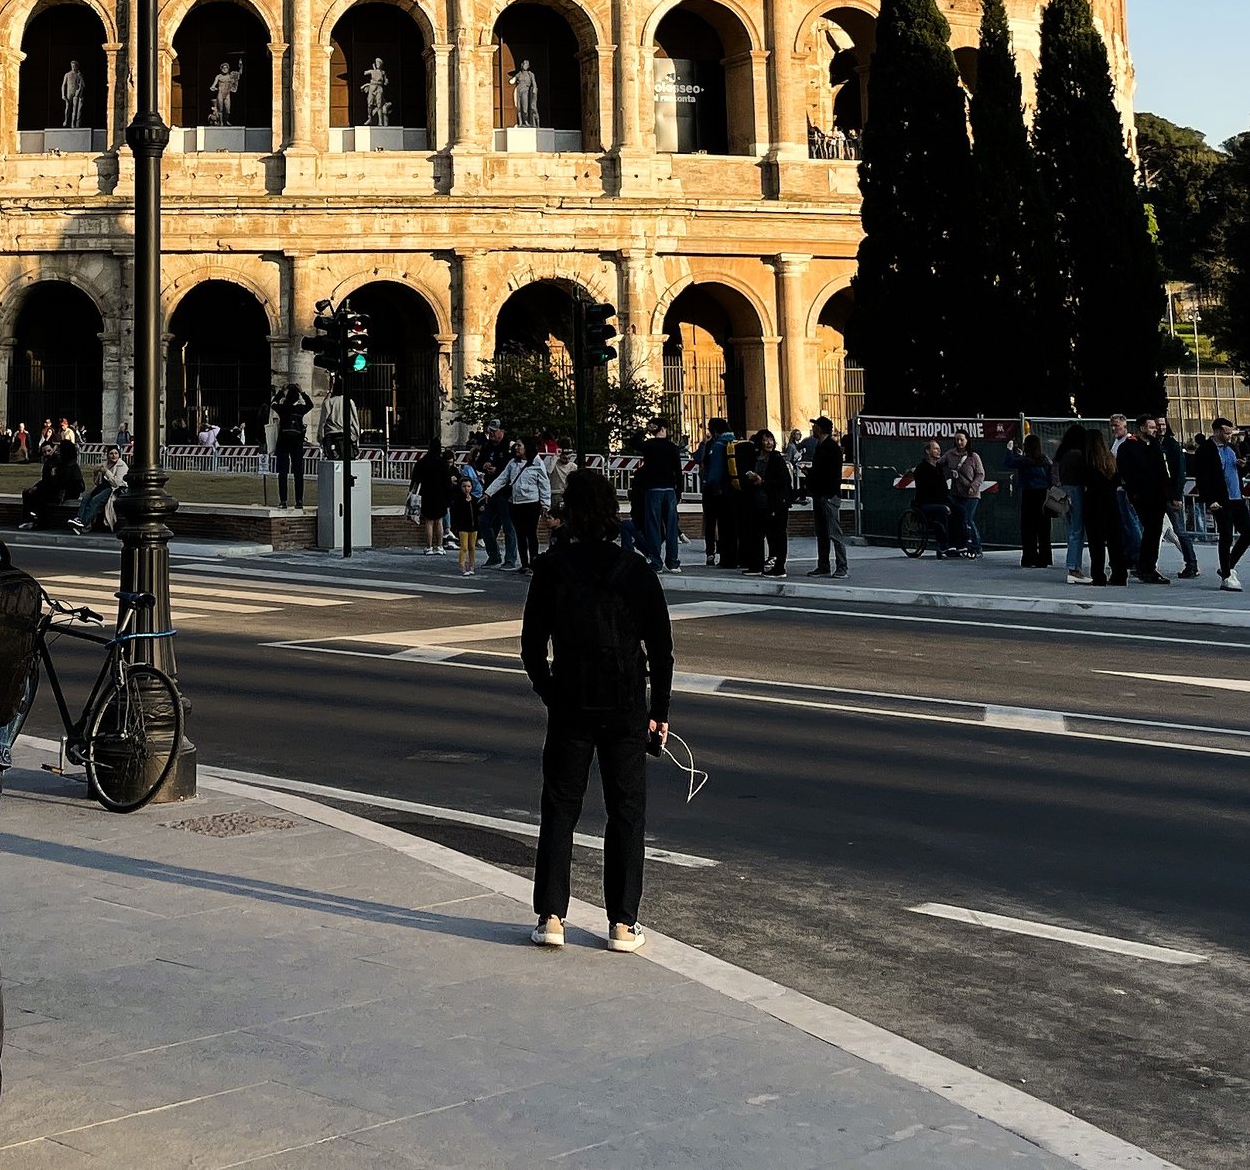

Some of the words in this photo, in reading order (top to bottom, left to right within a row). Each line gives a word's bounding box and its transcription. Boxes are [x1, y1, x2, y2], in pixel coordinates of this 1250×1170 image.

[654, 81, 700, 94] olosseo
[865, 421, 897, 437] ROMA
[899, 422, 984, 438] METROPOLITANE
